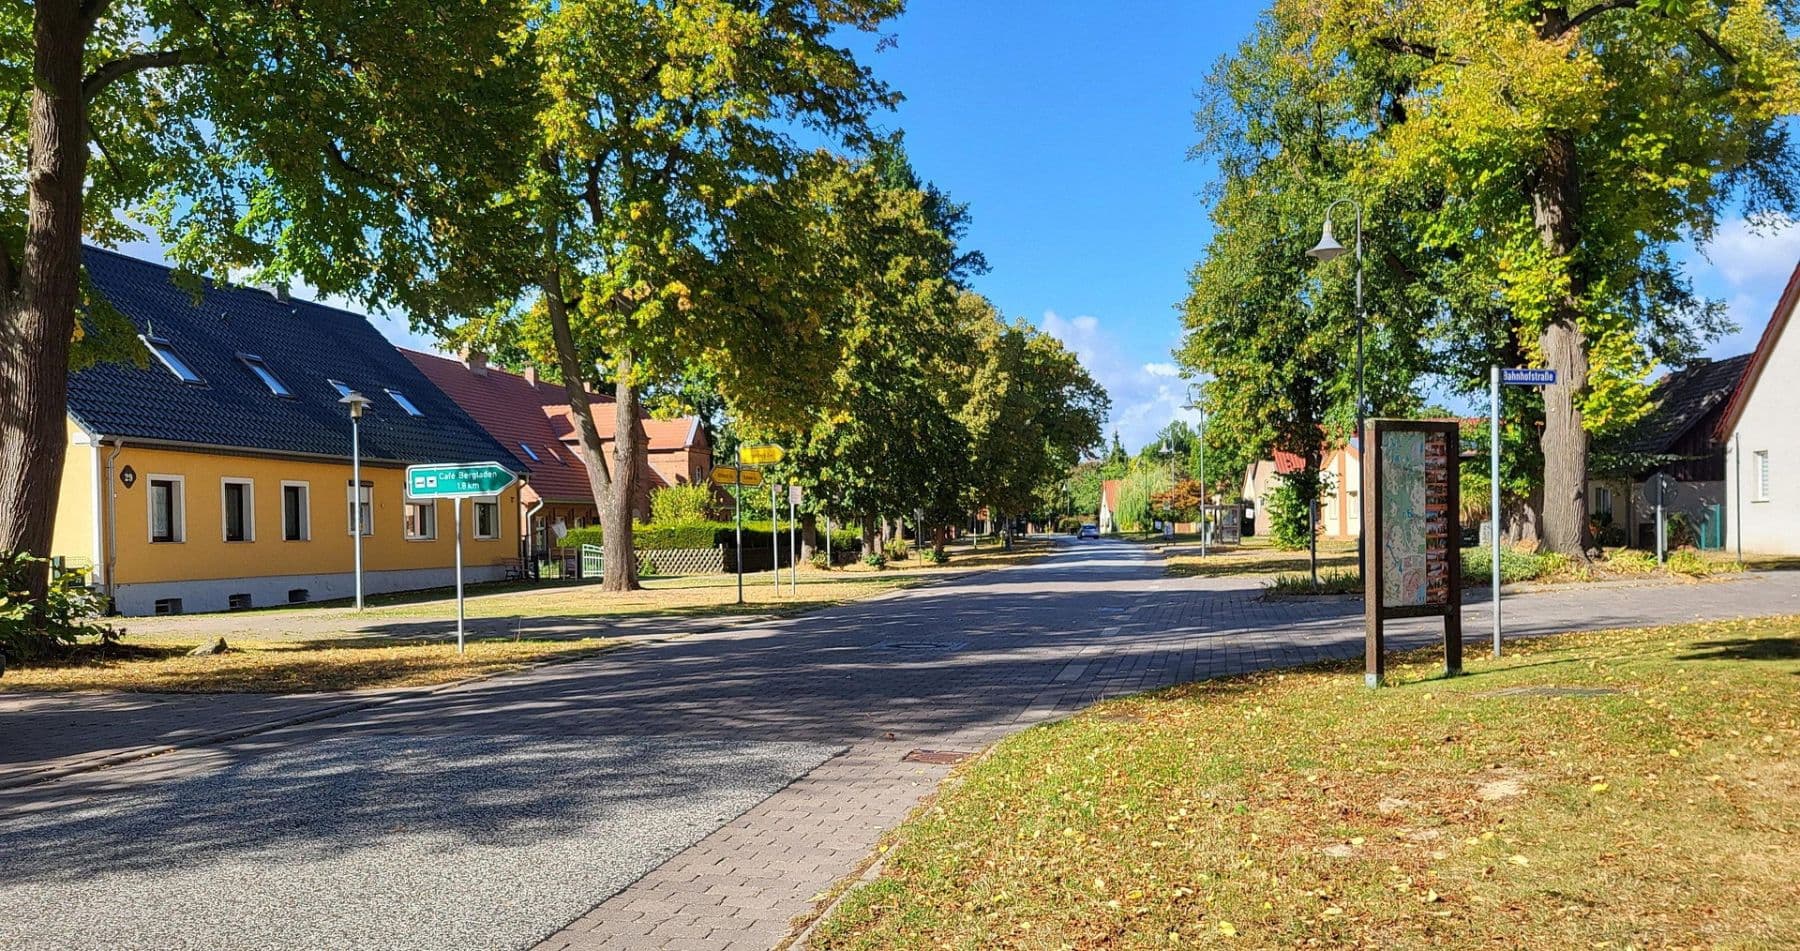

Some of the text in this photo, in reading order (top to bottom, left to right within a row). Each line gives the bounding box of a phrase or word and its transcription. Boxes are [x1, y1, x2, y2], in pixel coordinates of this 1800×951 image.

[1503, 370, 1553, 381] Bahnhofstraße
[438, 471, 497, 480] Café Bergladen
